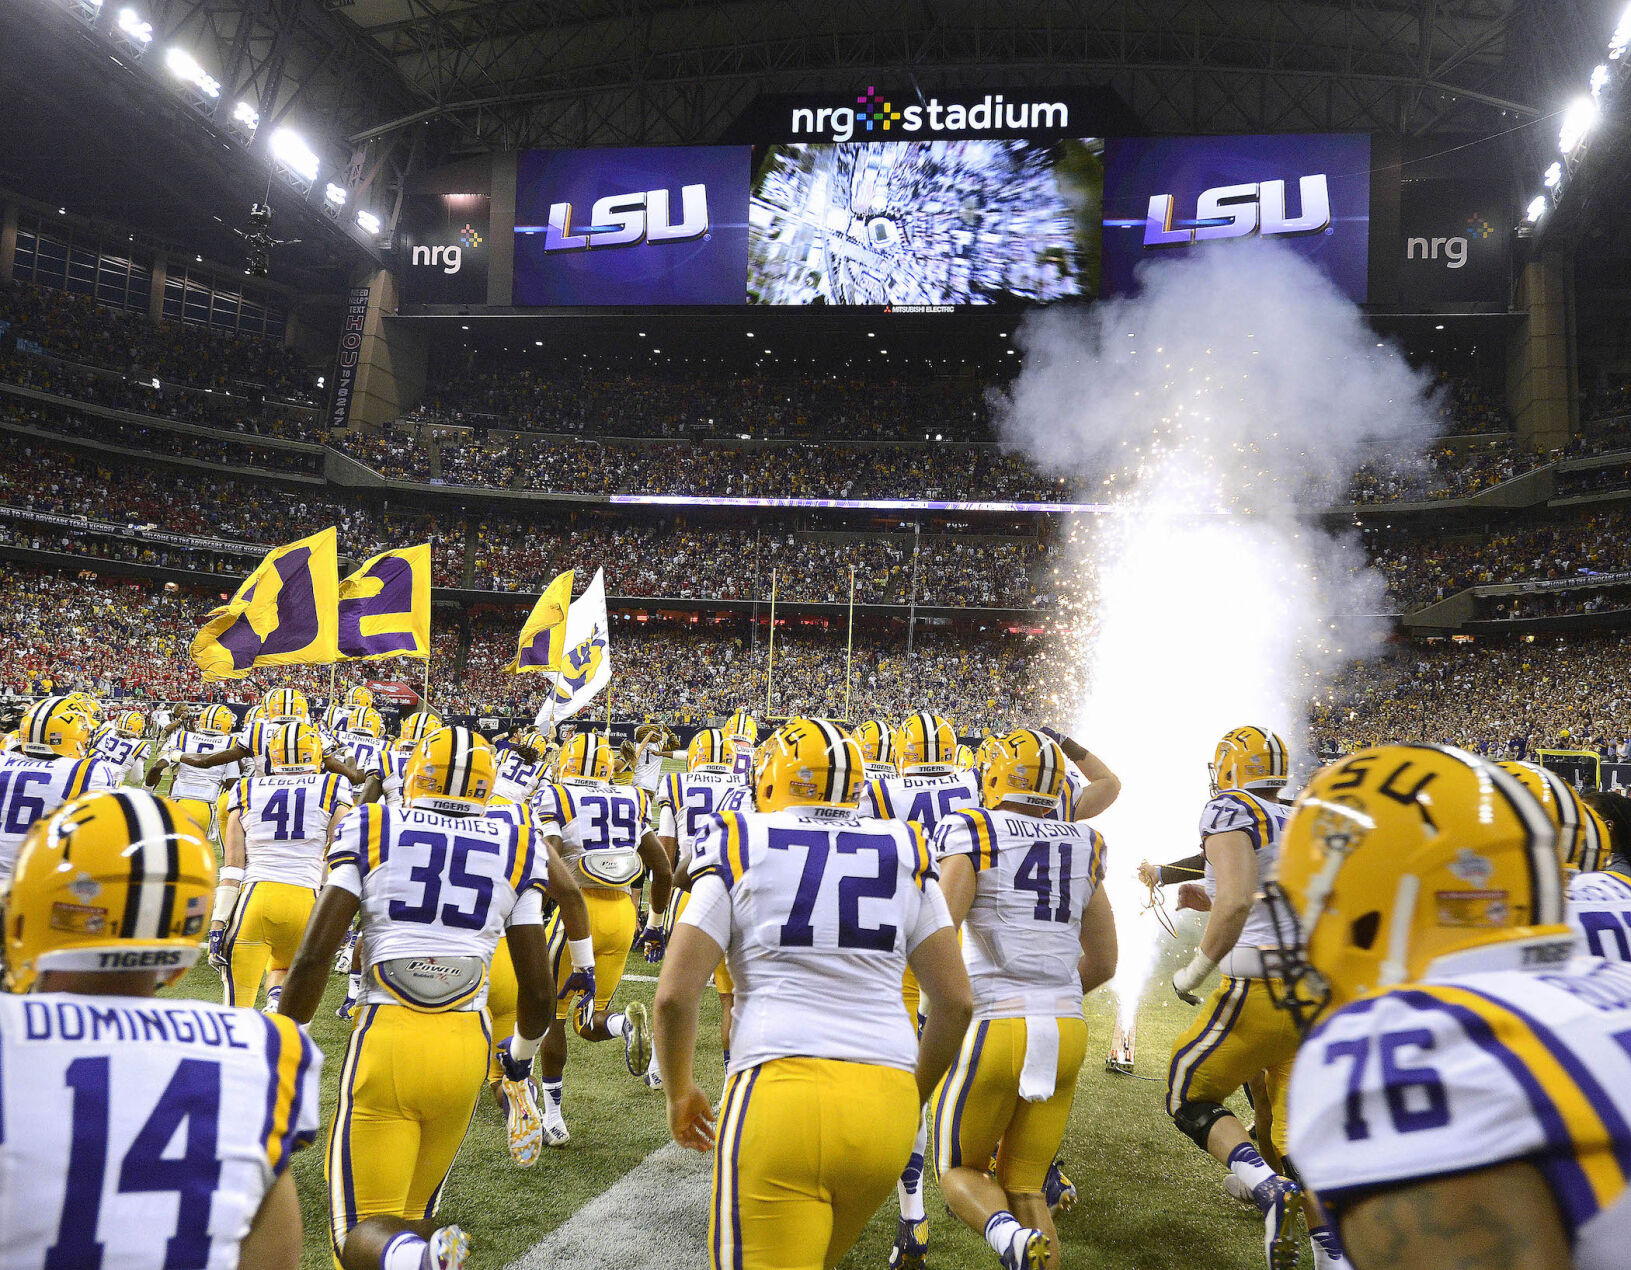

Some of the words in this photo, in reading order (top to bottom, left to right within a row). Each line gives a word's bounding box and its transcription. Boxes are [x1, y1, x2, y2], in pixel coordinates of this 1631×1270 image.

[792, 107, 854, 141] nrg
[902, 95, 1068, 131] stadium
[544, 184, 709, 255] LSU
[1143, 173, 1331, 249] LSU
[412, 245, 462, 274] nrg
[1407, 236, 1468, 269] nrg
[892, 305, 925, 313] MITSUBISHI
[925, 305, 955, 313] ELECTRIC
[341, 733, 380, 746] JENNINGS
[501, 755, 537, 787] 32
[726, 774, 742, 783] JR
[870, 763, 892, 771] TIGERS
[261, 787, 307, 840] 41
[432, 800, 471, 812] TIGERS
[814, 807, 851, 819] TIGERS
[1026, 795, 1055, 806] TIGERS
[398, 808, 499, 836] VOORHIES
[581, 796, 636, 851] 39
[1004, 818, 1081, 838] DICKSON
[1210, 804, 1239, 829] 77
[389, 829, 500, 931] 35
[768, 827, 899, 952] 72
[1014, 841, 1073, 923] 41
[99, 951, 181, 968] TIGERS
[23, 1001, 249, 1049] DOMINGUE
[1322, 1028, 1451, 1141] 76
[550, 1126, 567, 1140] NIKE
[44, 1056, 222, 1270] 14
